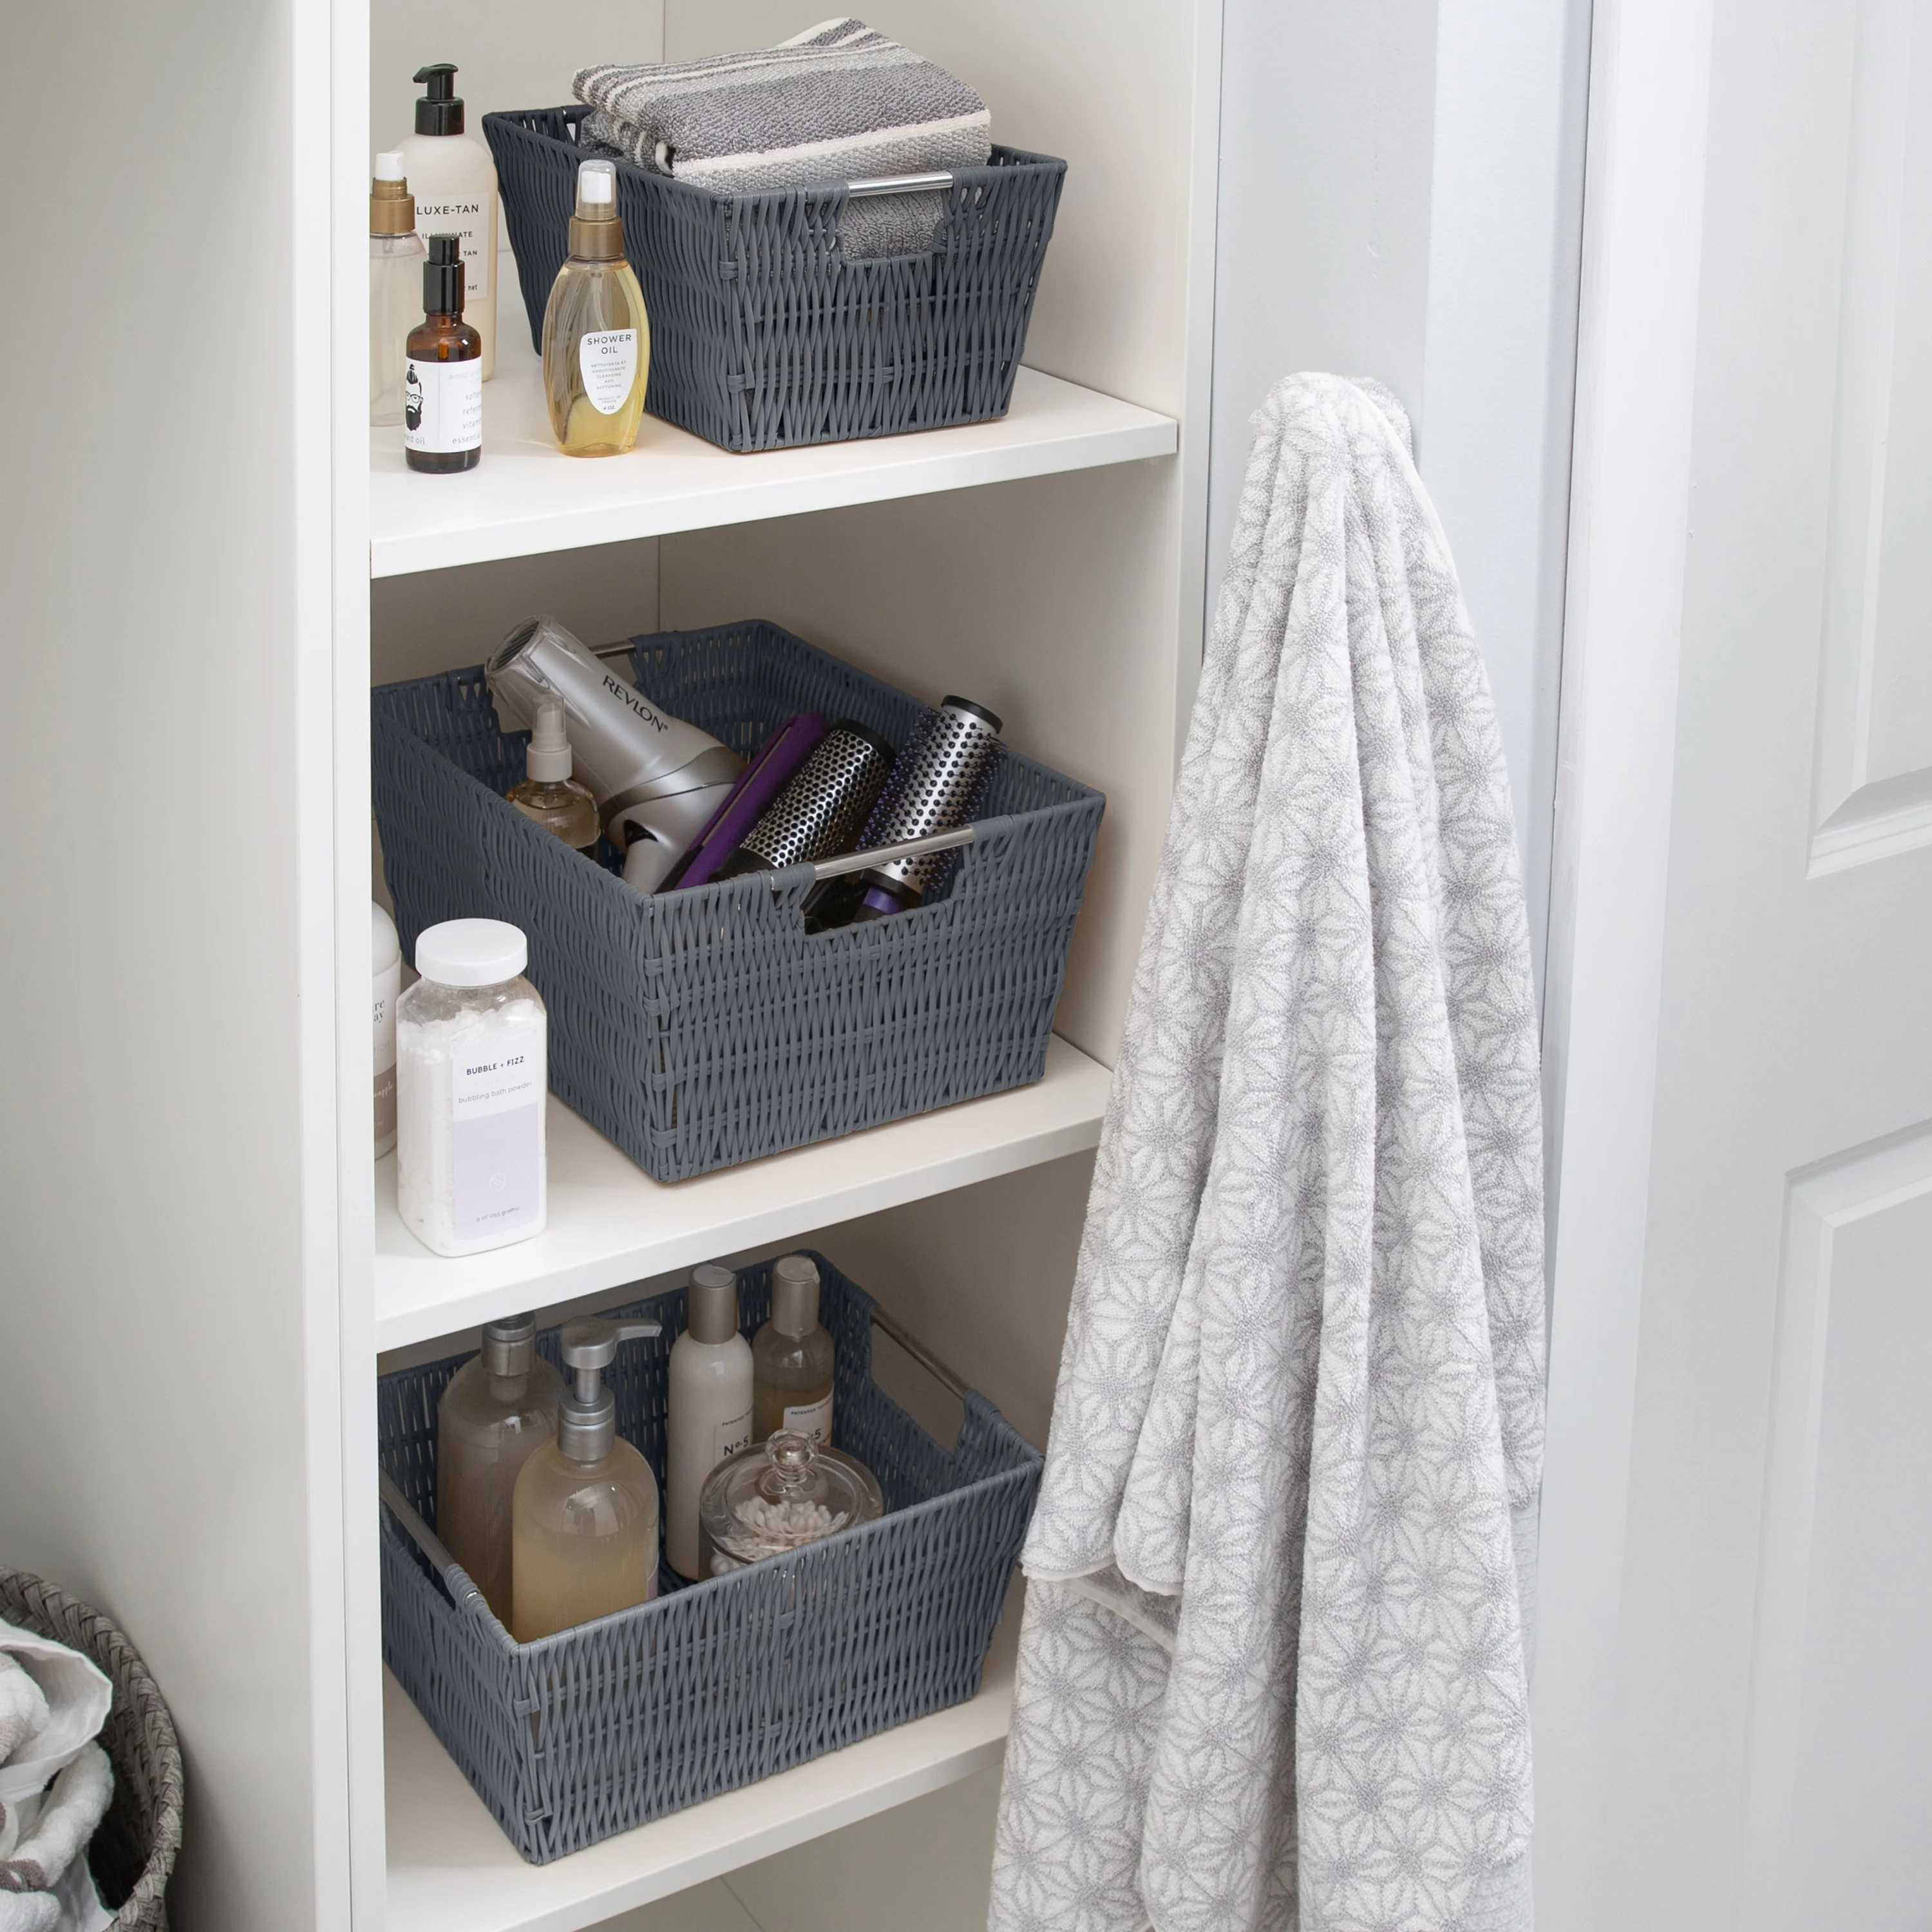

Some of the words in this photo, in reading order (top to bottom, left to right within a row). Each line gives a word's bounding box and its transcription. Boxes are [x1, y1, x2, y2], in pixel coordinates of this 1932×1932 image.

[417, 204, 478, 215] LUXE-TAN
[587, 334, 632, 345] SHOWER
[415, 436, 425, 445] oil
[466, 1063, 497, 1075] BUBBLE
[507, 1056, 525, 1066] FIZZ
[459, 1093, 489, 1104] bubbling
[491, 1088, 506, 1097] bath
[508, 1081, 533, 1094] powder
